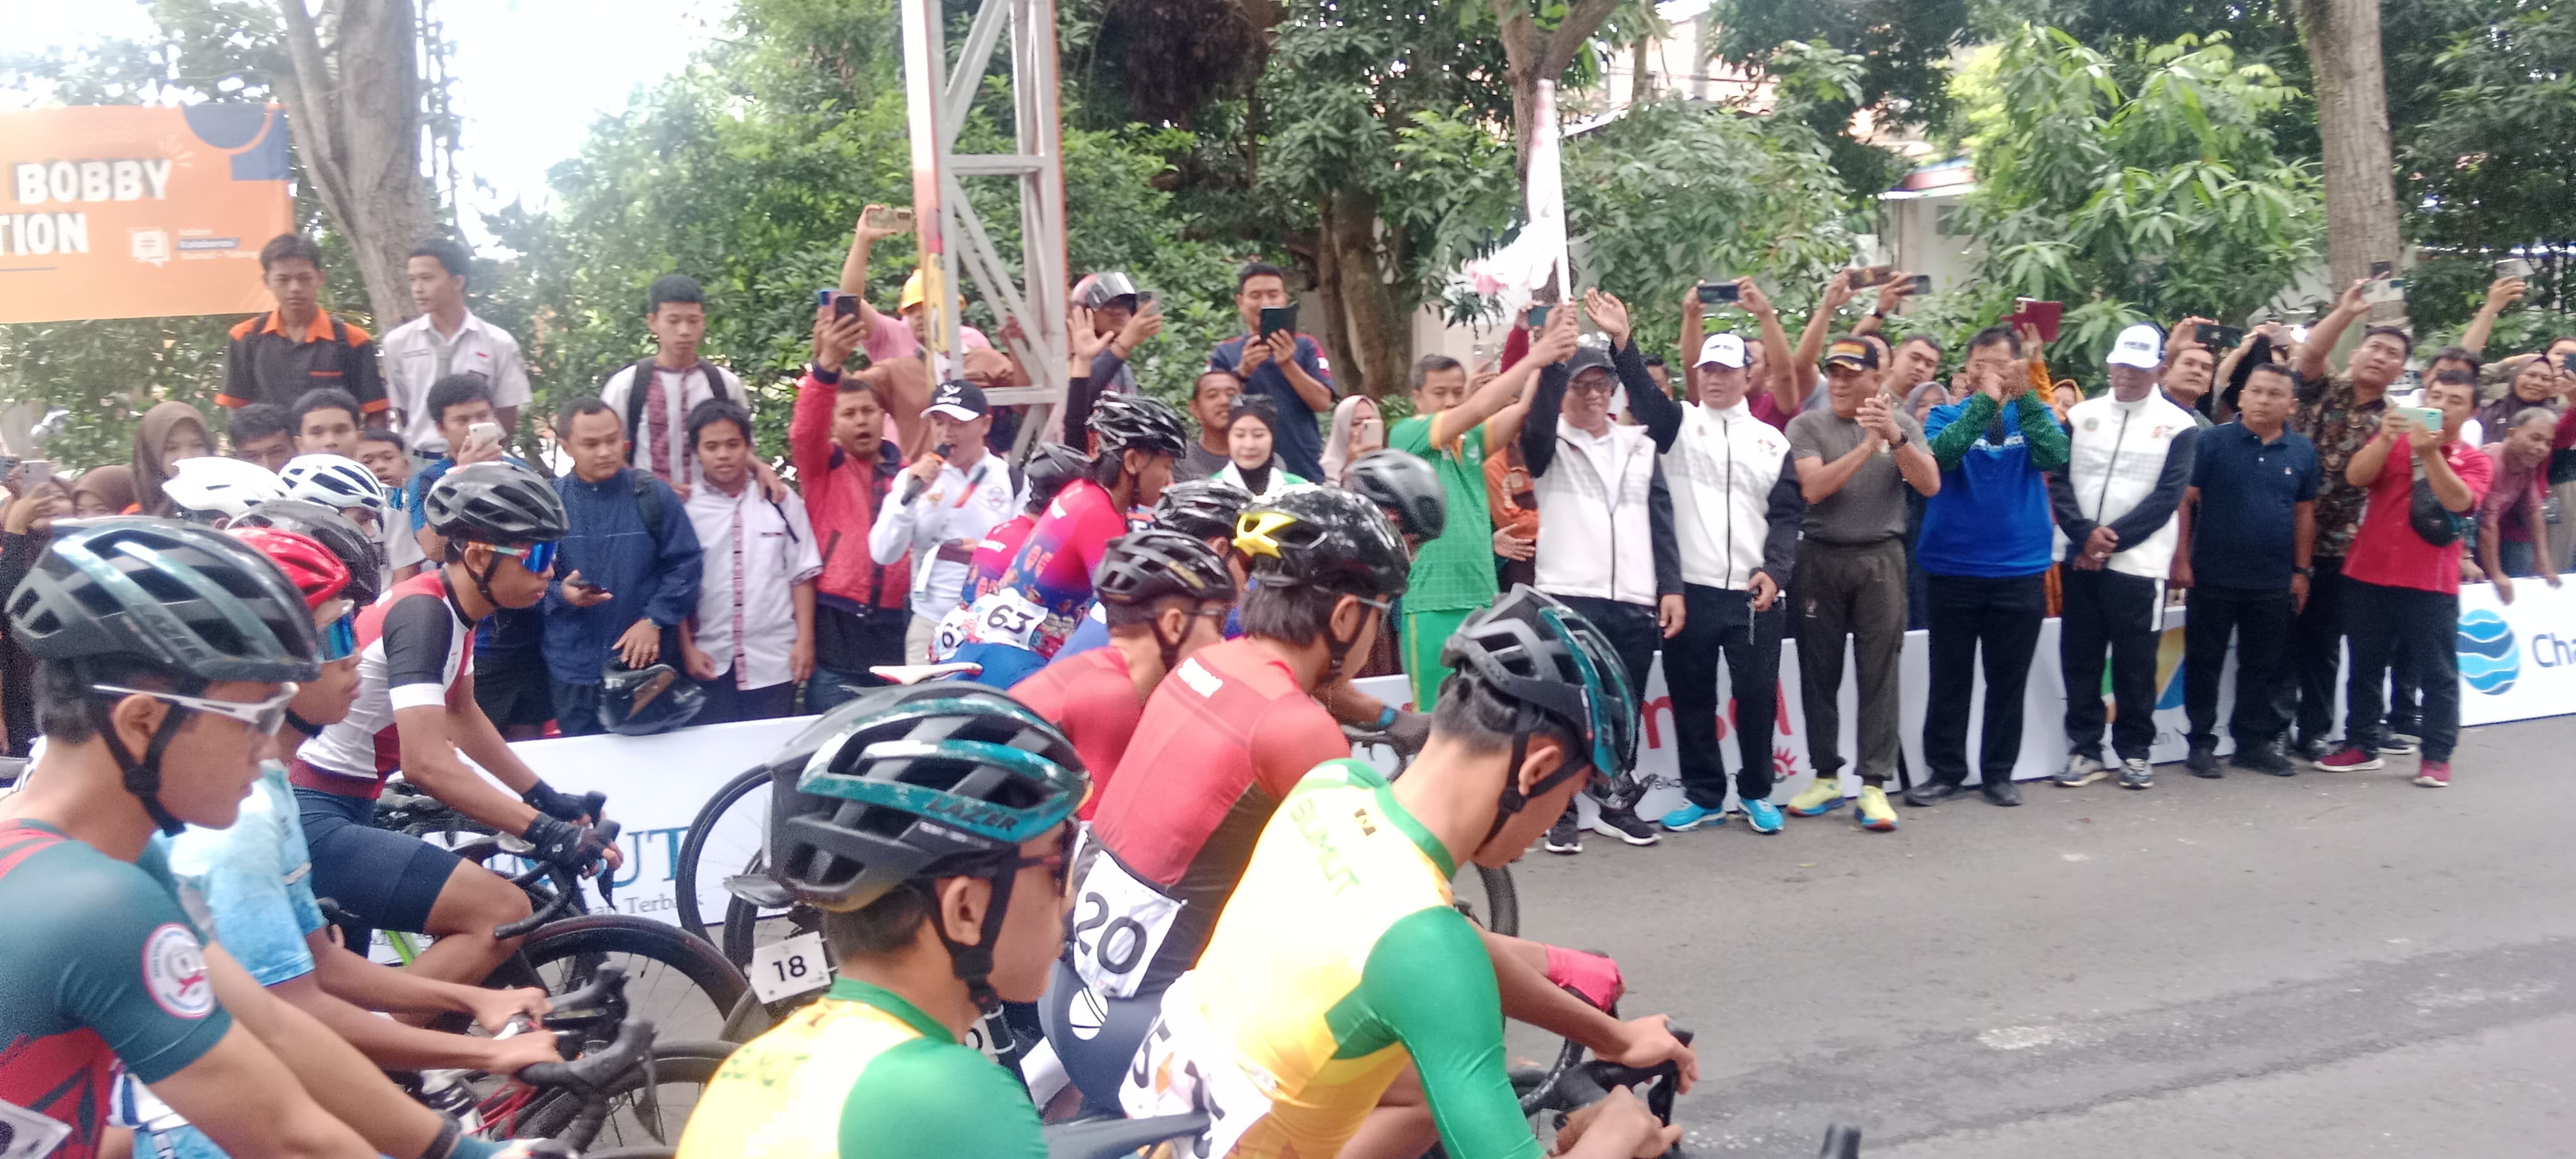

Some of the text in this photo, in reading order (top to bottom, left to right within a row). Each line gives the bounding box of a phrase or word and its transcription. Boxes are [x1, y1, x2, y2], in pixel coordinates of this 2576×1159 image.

[15, 159, 172, 204] BOBBY
[987, 604, 1035, 634] 63
[941, 622, 966, 649] 6
[925, 796, 1021, 831] LAZER
[1075, 891, 1148, 975] 20
[772, 954, 807, 982] 18
